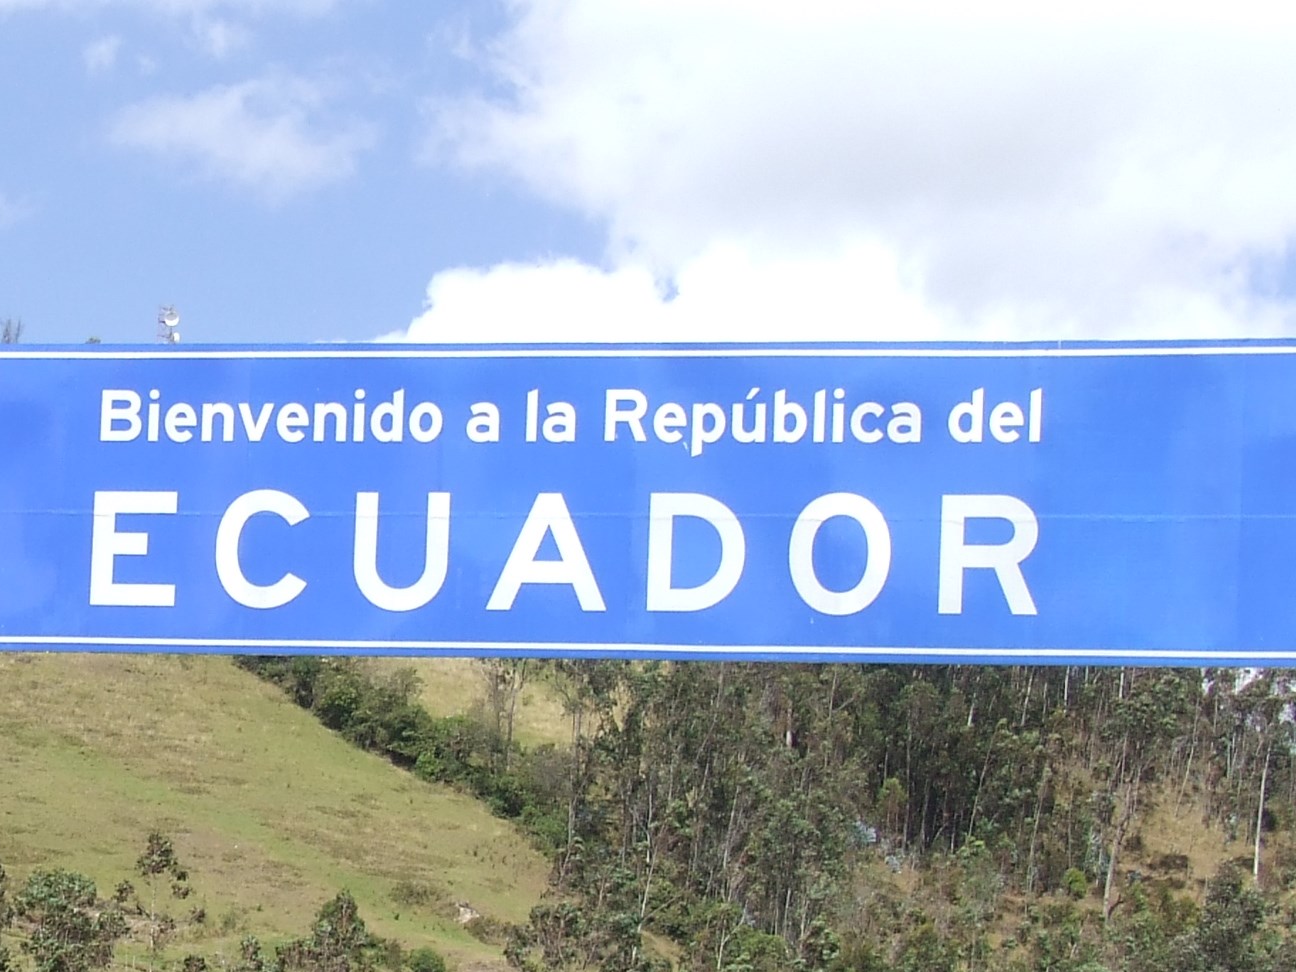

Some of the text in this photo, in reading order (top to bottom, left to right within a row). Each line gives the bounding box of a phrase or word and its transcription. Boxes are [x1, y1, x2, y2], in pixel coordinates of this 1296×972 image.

[99, 388, 1043, 457] Bienvenido a la República del
[89, 489, 1040, 617] ECUADOR
